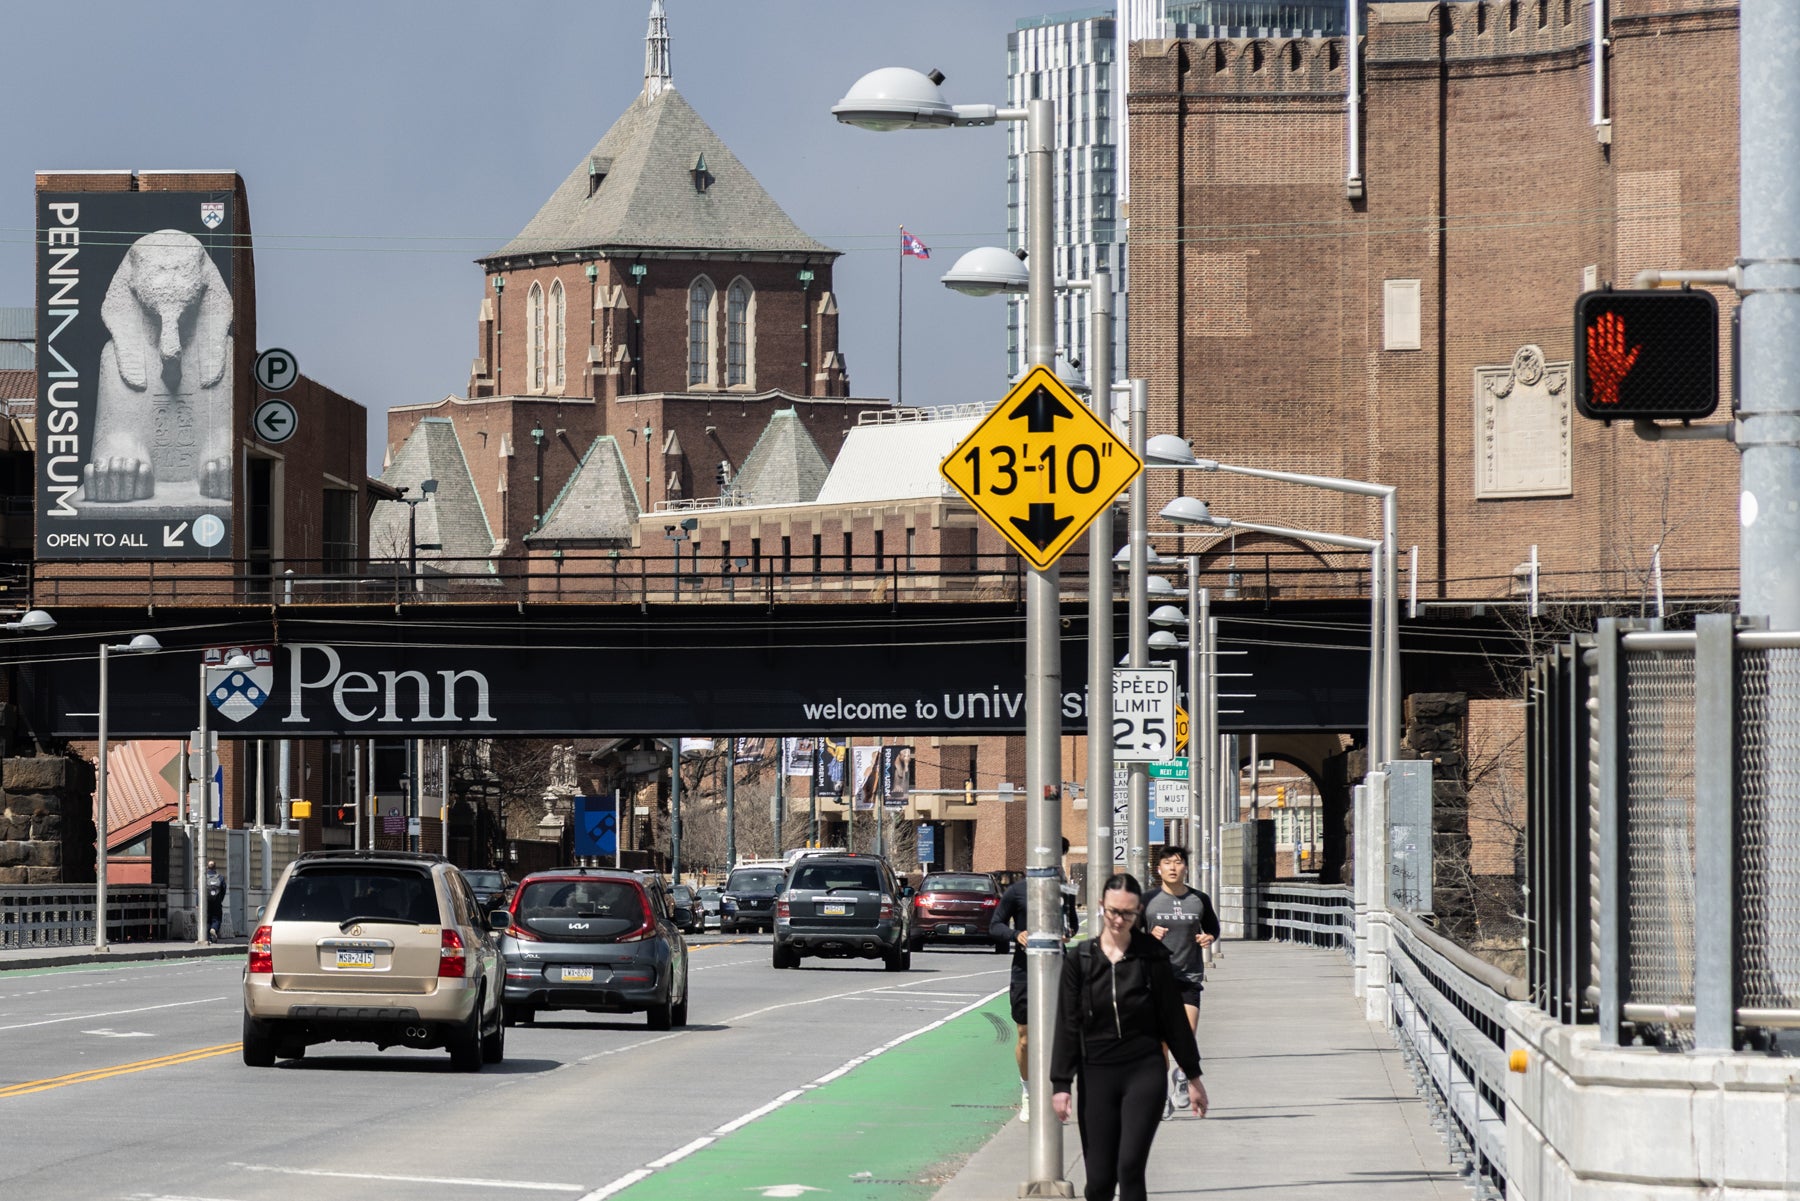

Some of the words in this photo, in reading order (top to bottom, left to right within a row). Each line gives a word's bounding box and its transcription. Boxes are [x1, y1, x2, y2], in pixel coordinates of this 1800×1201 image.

[267, 356, 288, 384] P
[964, 442, 1113, 496] 13'-10"
[46, 533, 89, 547] OPEN
[94, 533, 116, 547] TO
[119, 533, 148, 547] ALL
[281, 642, 498, 723] Penn
[803, 697, 908, 720] welcome
[915, 699, 938, 720] to
[1114, 698, 1162, 713] LIMIT
[1113, 717, 1167, 750] 25
[1164, 794, 1185, 803] MUST
